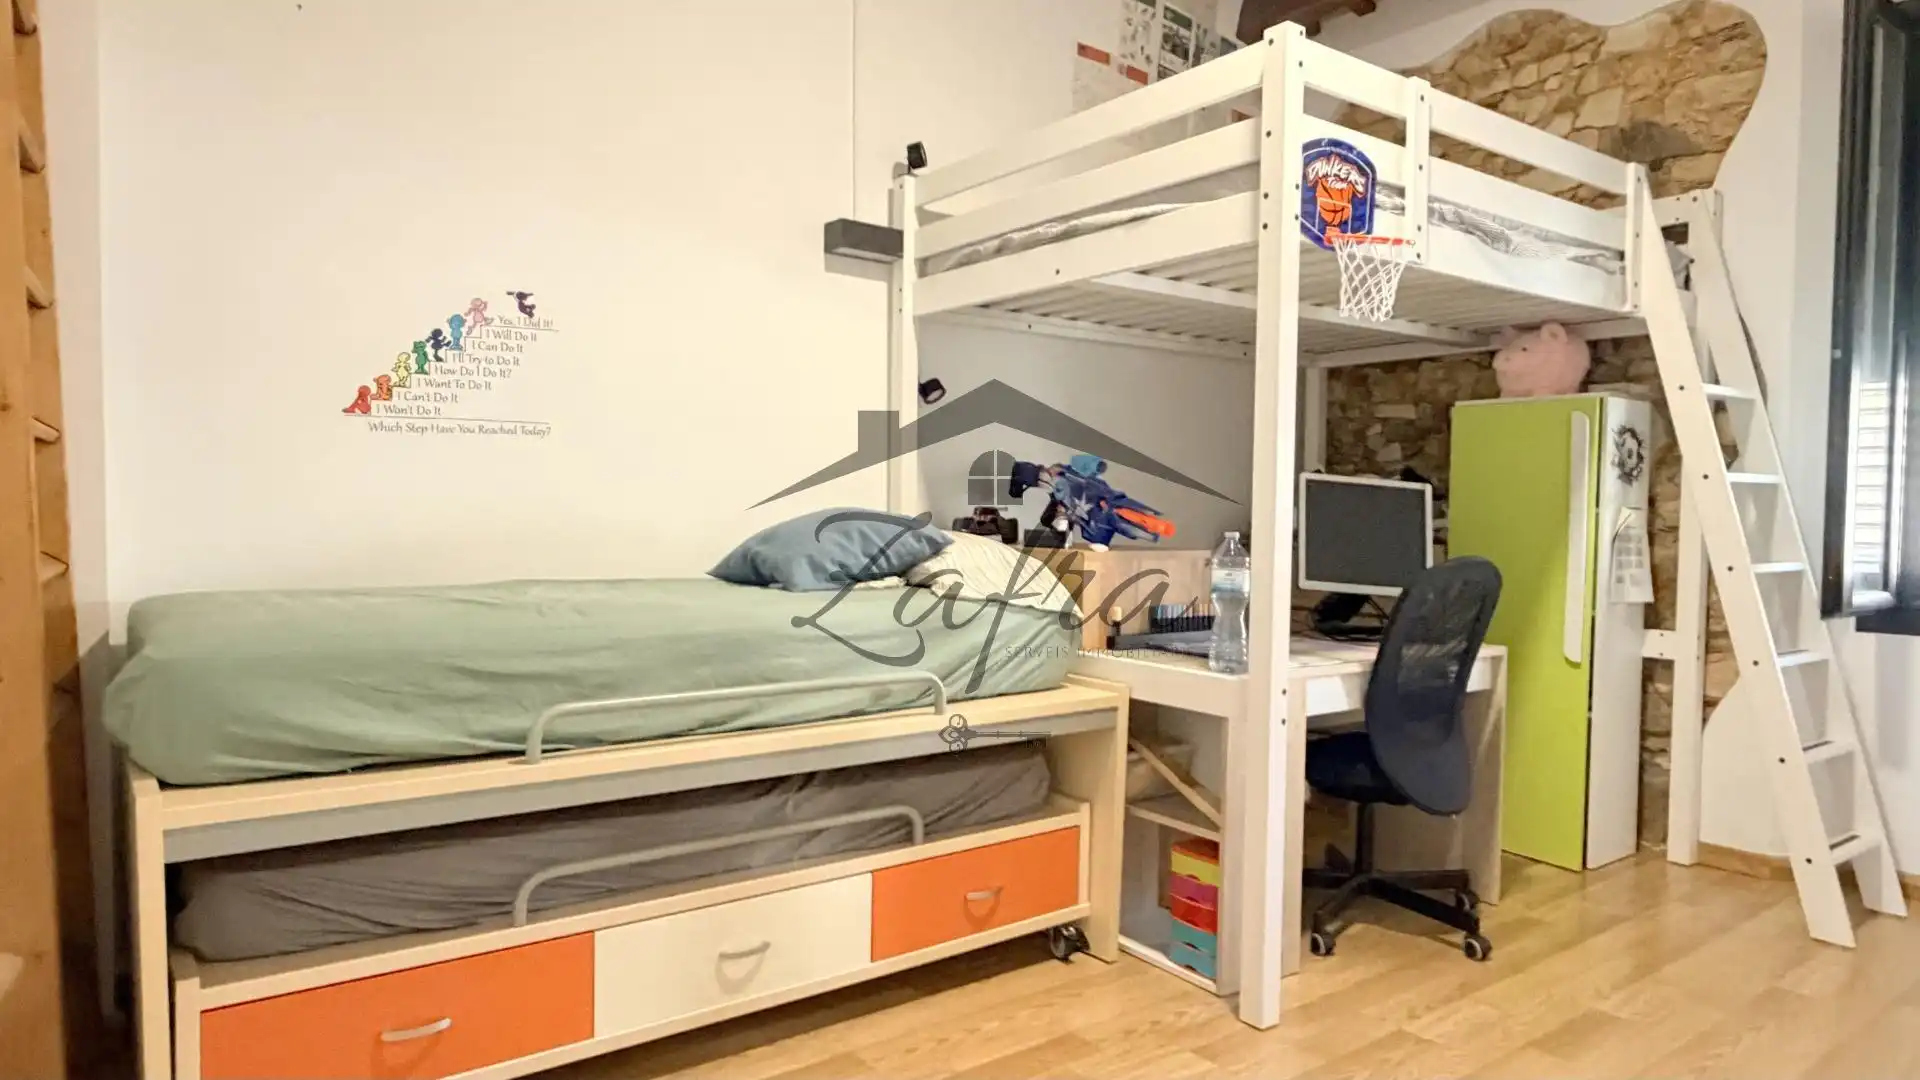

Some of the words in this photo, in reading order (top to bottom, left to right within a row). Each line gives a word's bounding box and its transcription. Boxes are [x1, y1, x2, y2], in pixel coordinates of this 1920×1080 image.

[493, 329, 512, 340] Will
[515, 331, 528, 342] Do
[531, 332, 537, 342] It
[478, 341, 497, 352] Can
[501, 342, 514, 352] Do
[517, 343, 523, 353] It
[497, 356, 511, 366] Do
[513, 357, 520, 367] It
[434, 365, 457, 375] How
[460, 366, 474, 377] Do
[483, 367, 497, 378] Do
[500, 368, 512, 379] It?
[424, 378, 451, 389] Want
[468, 380, 482, 390] Do
[485, 381, 492, 391] It
[404, 391, 431, 402] Can't
[434, 393, 448, 403] Do
[451, 393, 459, 403] It
[383, 404, 413, 415] Won't
[416, 406, 432, 416] Do
[434, 406, 441, 416] It
[368, 421, 403, 433] Which
[405, 422, 428, 436] Step
[431, 424, 456, 434] Have
[457, 424, 475, 434] You
[478, 424, 518, 436] Reached
[520, 426, 551, 439] Today?
